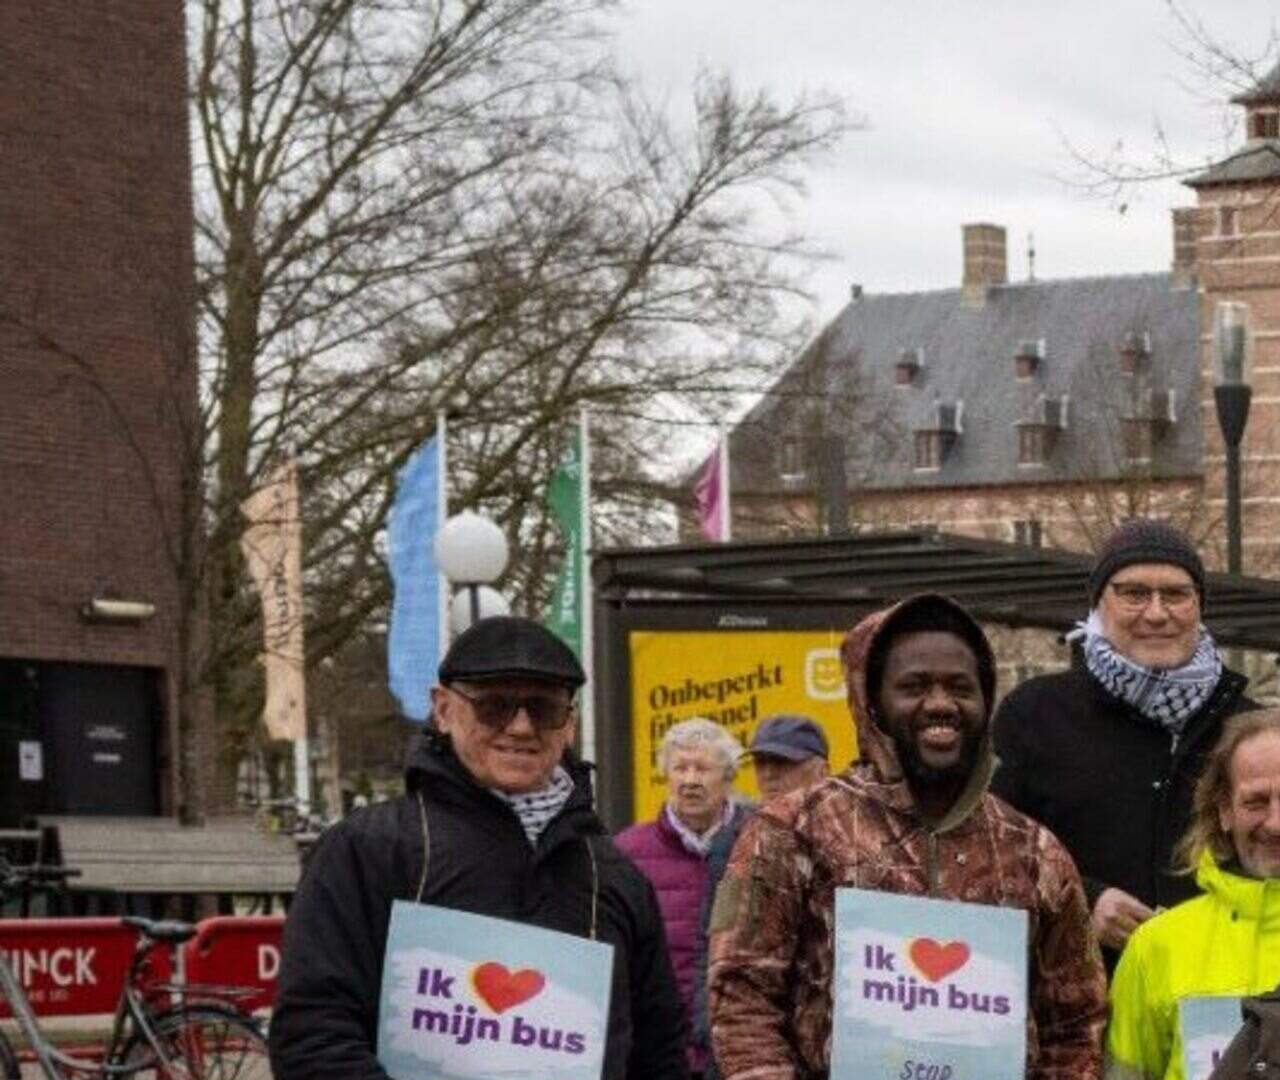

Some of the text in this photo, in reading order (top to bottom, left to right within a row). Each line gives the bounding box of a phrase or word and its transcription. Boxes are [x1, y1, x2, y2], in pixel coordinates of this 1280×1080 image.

[650, 664, 782, 710] Onbeperkt
[864, 944, 896, 972] Ik
[416, 967, 455, 999] Ik
[863, 975, 1011, 1016] mijn bus
[411, 1004, 586, 1055] mijn bus
